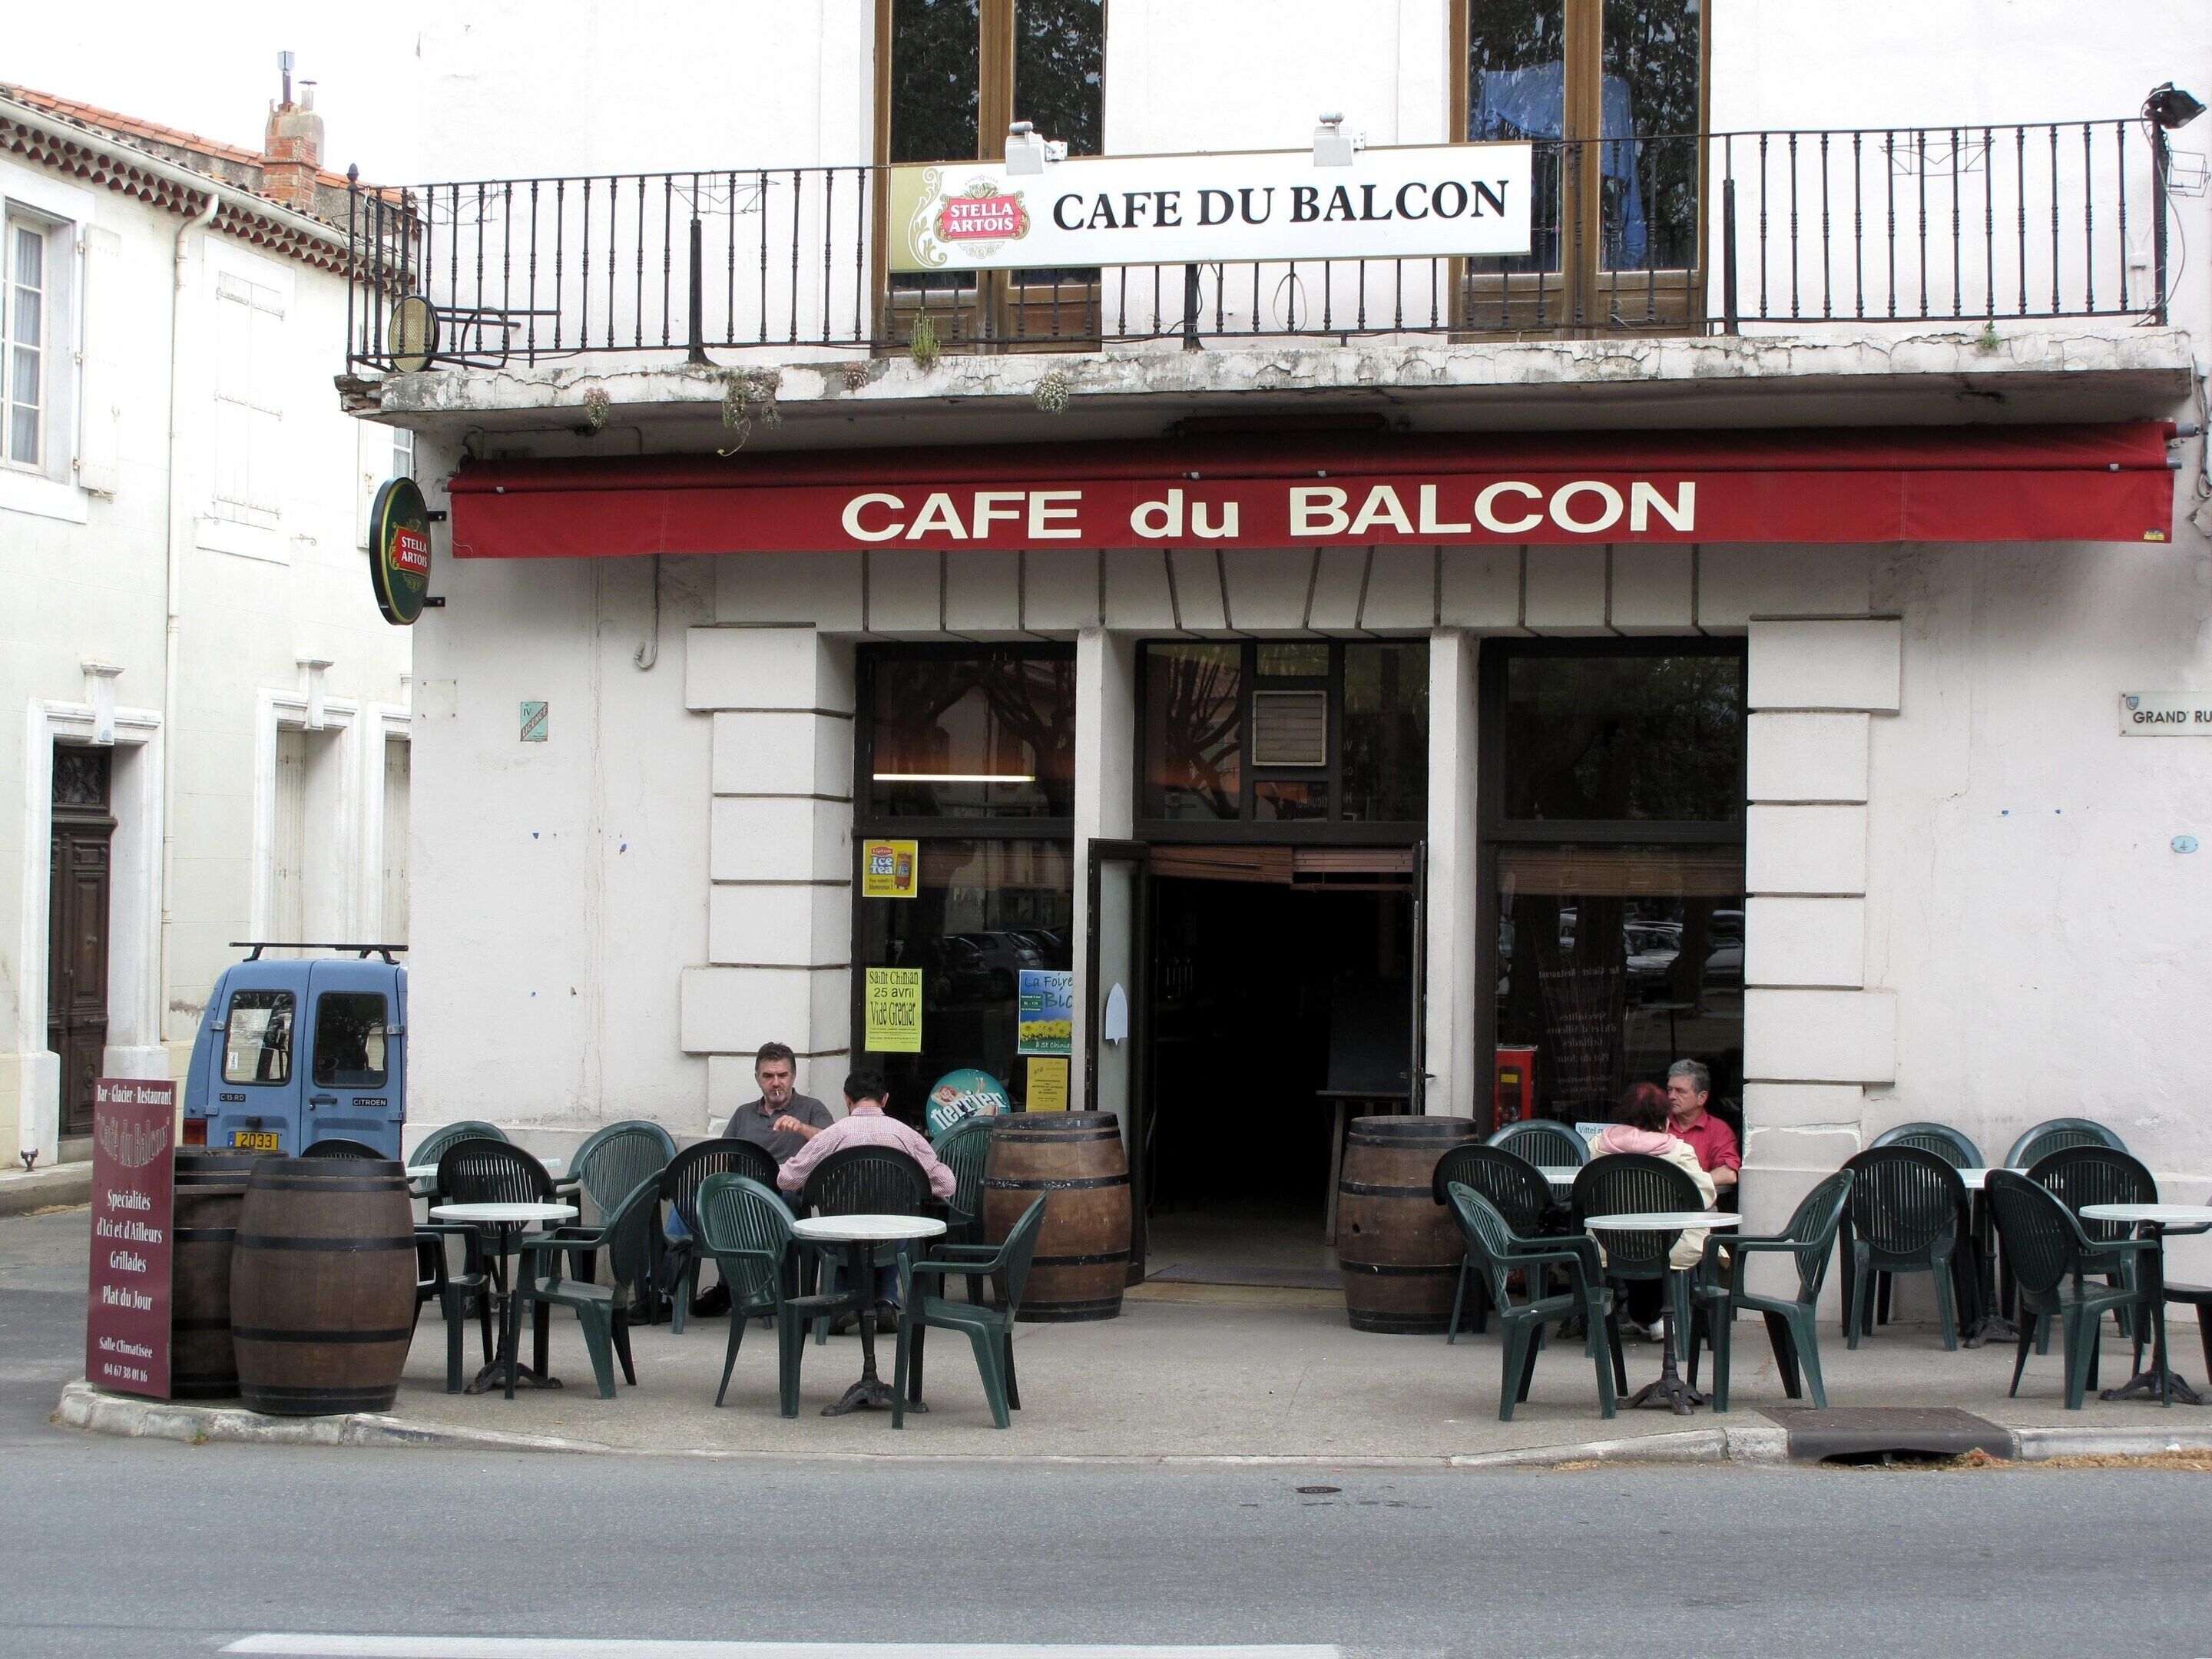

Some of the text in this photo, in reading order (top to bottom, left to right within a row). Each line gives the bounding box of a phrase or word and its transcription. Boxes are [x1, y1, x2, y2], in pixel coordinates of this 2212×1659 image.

[950, 202, 1014, 218] STELLA
[1053, 180, 1509, 231] CAFE DU BALCON
[949, 217, 1014, 233] ARTOIS
[841, 481, 1697, 542] CAFE du BALCON
[401, 536, 428, 554] STELLA
[401, 551, 428, 568] ARTOIS
[869, 865, 894, 875] Tea
[871, 856, 893, 866] Ice
[869, 971, 919, 985] Saint Chinian
[874, 987, 914, 998] 25 avril
[870, 1001, 916, 1027] Vide Grenier
[97, 1084, 108, 1102] Bar
[111, 1084, 133, 1103] Glacier
[137, 1086, 171, 1105] Restaurant
[1578, 1125, 1596, 1134] Vittel
[240, 1133, 273, 1148] 2033
[108, 1188, 151, 1211] Spécialités
[114, 1221, 123, 1238] et
[124, 1220, 164, 1243] d'Ailleurs
[110, 1250, 147, 1273] Grillades
[103, 1284, 152, 1310] Plat du Jour
[99, 1336, 115, 1352] Salle
[116, 1339, 153, 1358] Climatisée
[104, 1363, 148, 1382] 04 67 38 01 16
